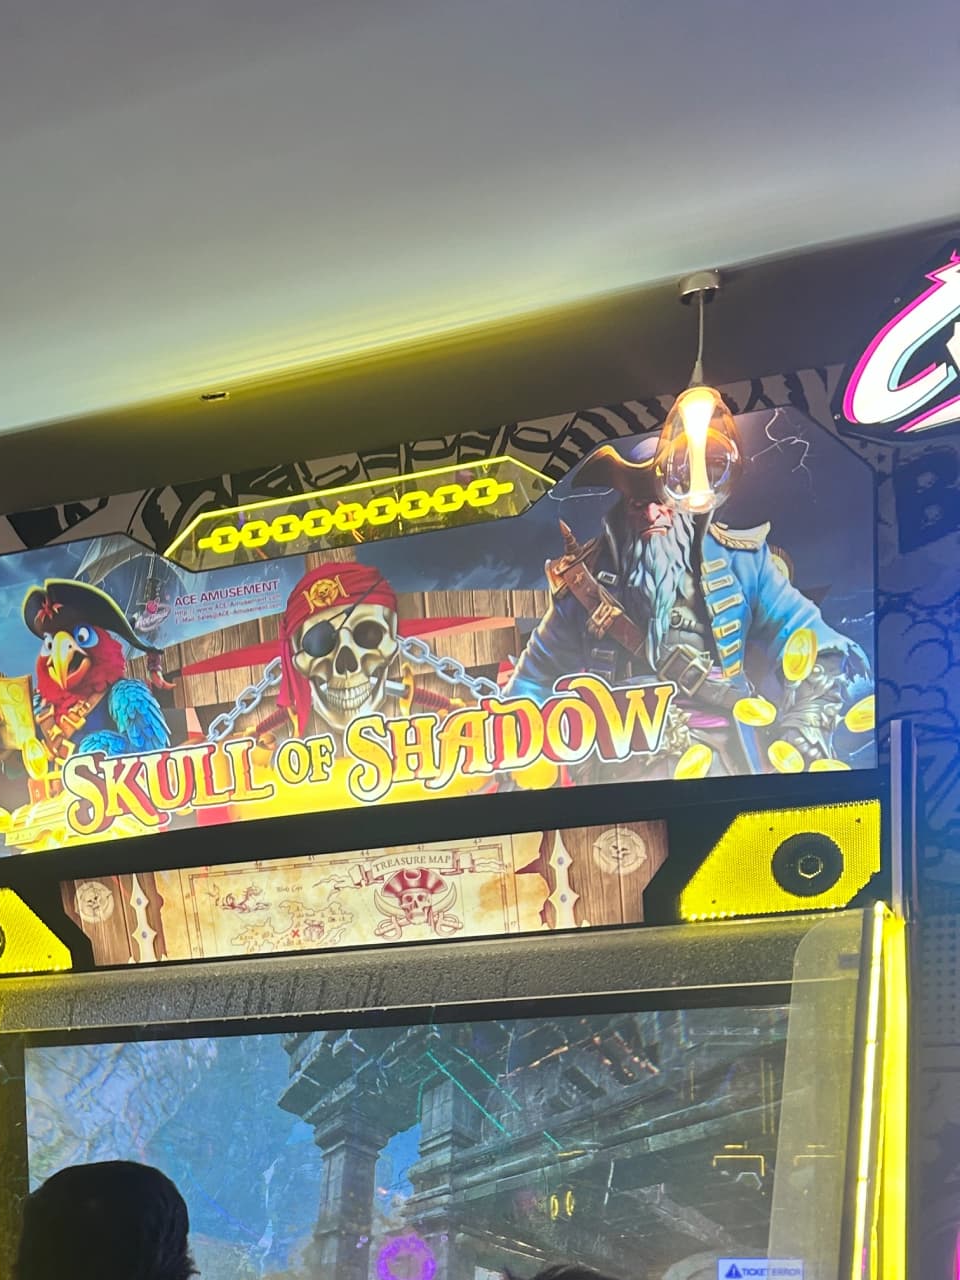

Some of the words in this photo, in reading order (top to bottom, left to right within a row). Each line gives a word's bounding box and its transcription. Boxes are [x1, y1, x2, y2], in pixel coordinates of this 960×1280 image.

[174, 592, 197, 608] ACE
[200, 579, 281, 603] AMUSEMENT
[63, 737, 274, 835] SKULL
[277, 735, 335, 784] OF
[345, 674, 676, 802] SHADOW
[373, 854, 427, 873] TREASURE
[428, 854, 451, 865] MAP
